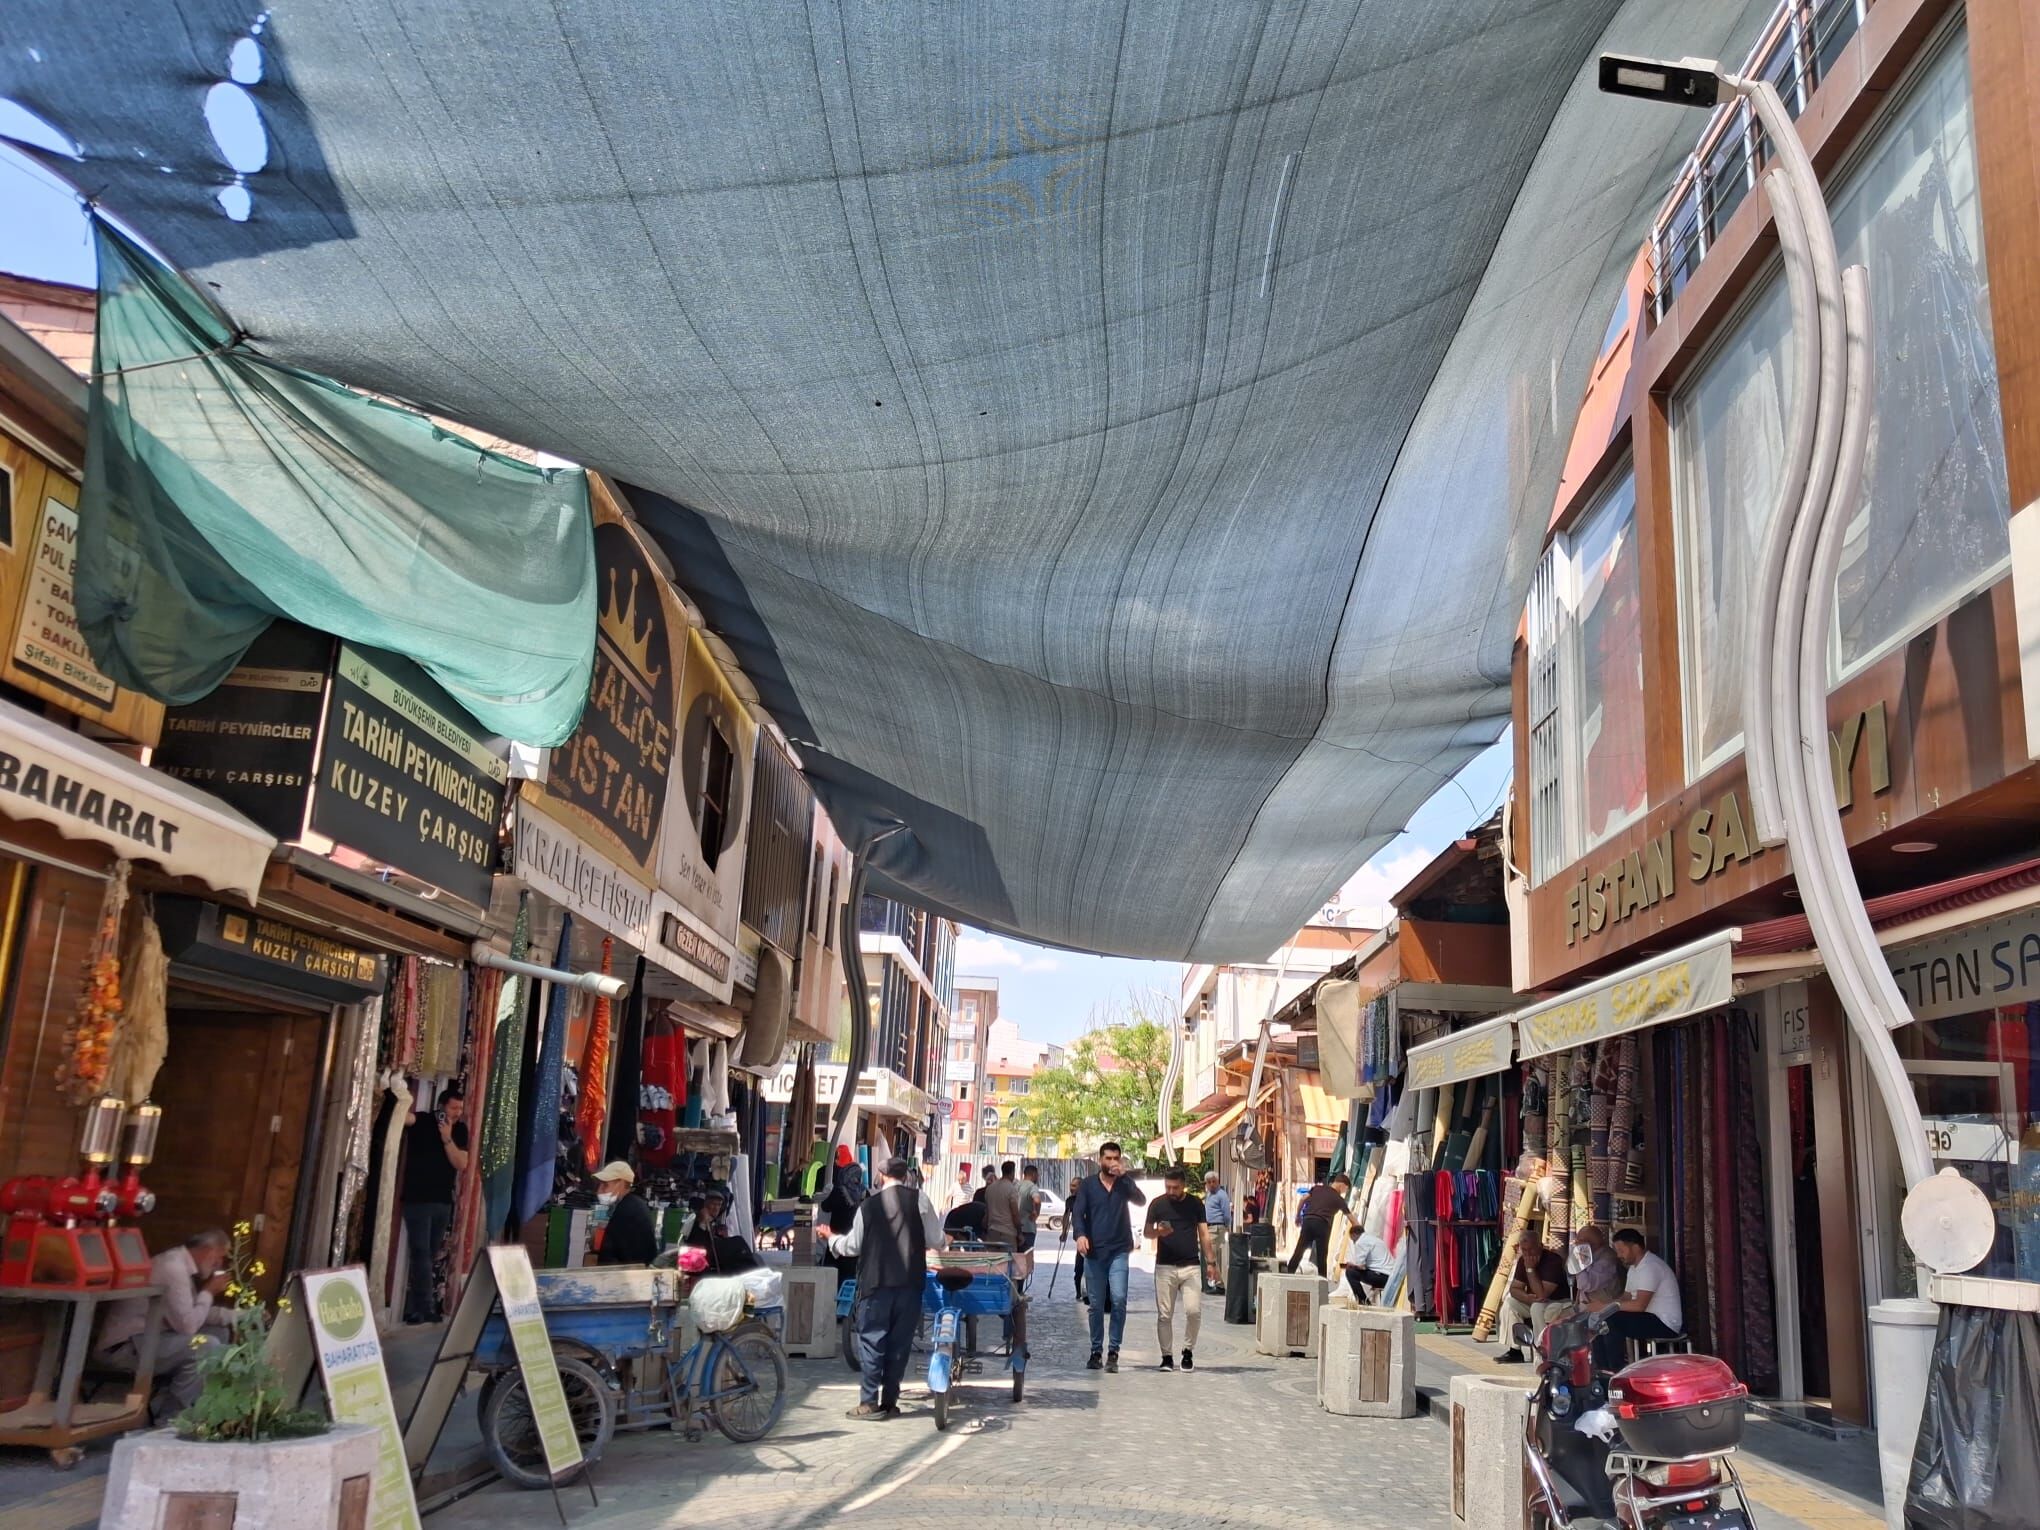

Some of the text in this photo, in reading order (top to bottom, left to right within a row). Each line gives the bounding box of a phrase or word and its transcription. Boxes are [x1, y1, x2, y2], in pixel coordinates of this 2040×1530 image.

[46, 516, 77, 545] ÇAV
[40, 543, 65, 571] PUL
[46, 604, 79, 631] TOH
[62, 661, 110, 694] Bitkiler
[219, 721, 312, 740] PEYNİRCİLER
[226, 770, 303, 787] ÇARŞISI
[343, 700, 496, 826] TARİHİ PEYNİRCİLER
[0, 751, 180, 854] BAHARAT
[331, 760, 490, 868] KUZEY ÇARŞISI
[1565, 700, 1890, 946] FİSTAN SAYI
[519, 816, 602, 909] KRALİÇE
[252, 938, 354, 981] KUZEY ÇARŞISI
